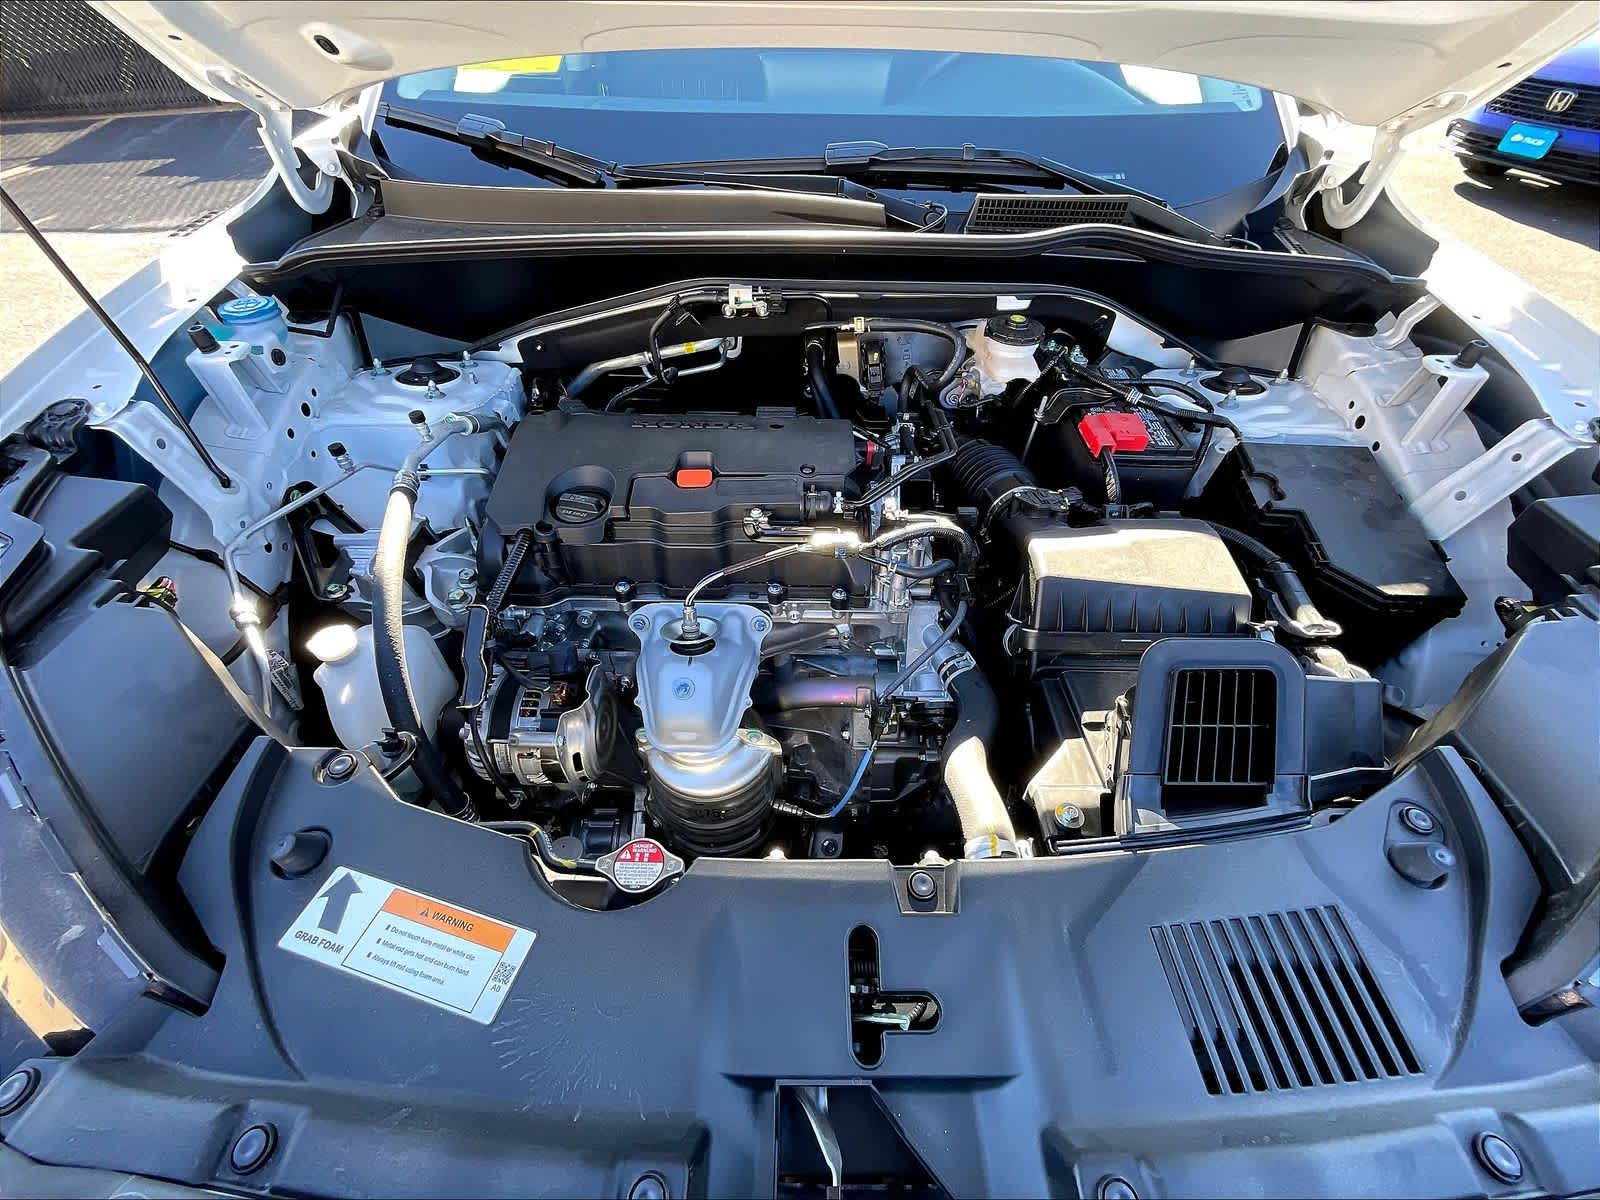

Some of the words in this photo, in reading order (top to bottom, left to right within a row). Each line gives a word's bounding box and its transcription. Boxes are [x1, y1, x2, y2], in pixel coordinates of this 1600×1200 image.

[432, 911, 474, 931] WARNING
[294, 930, 319, 944] GRAB
[318, 938, 344, 954] FOAM
